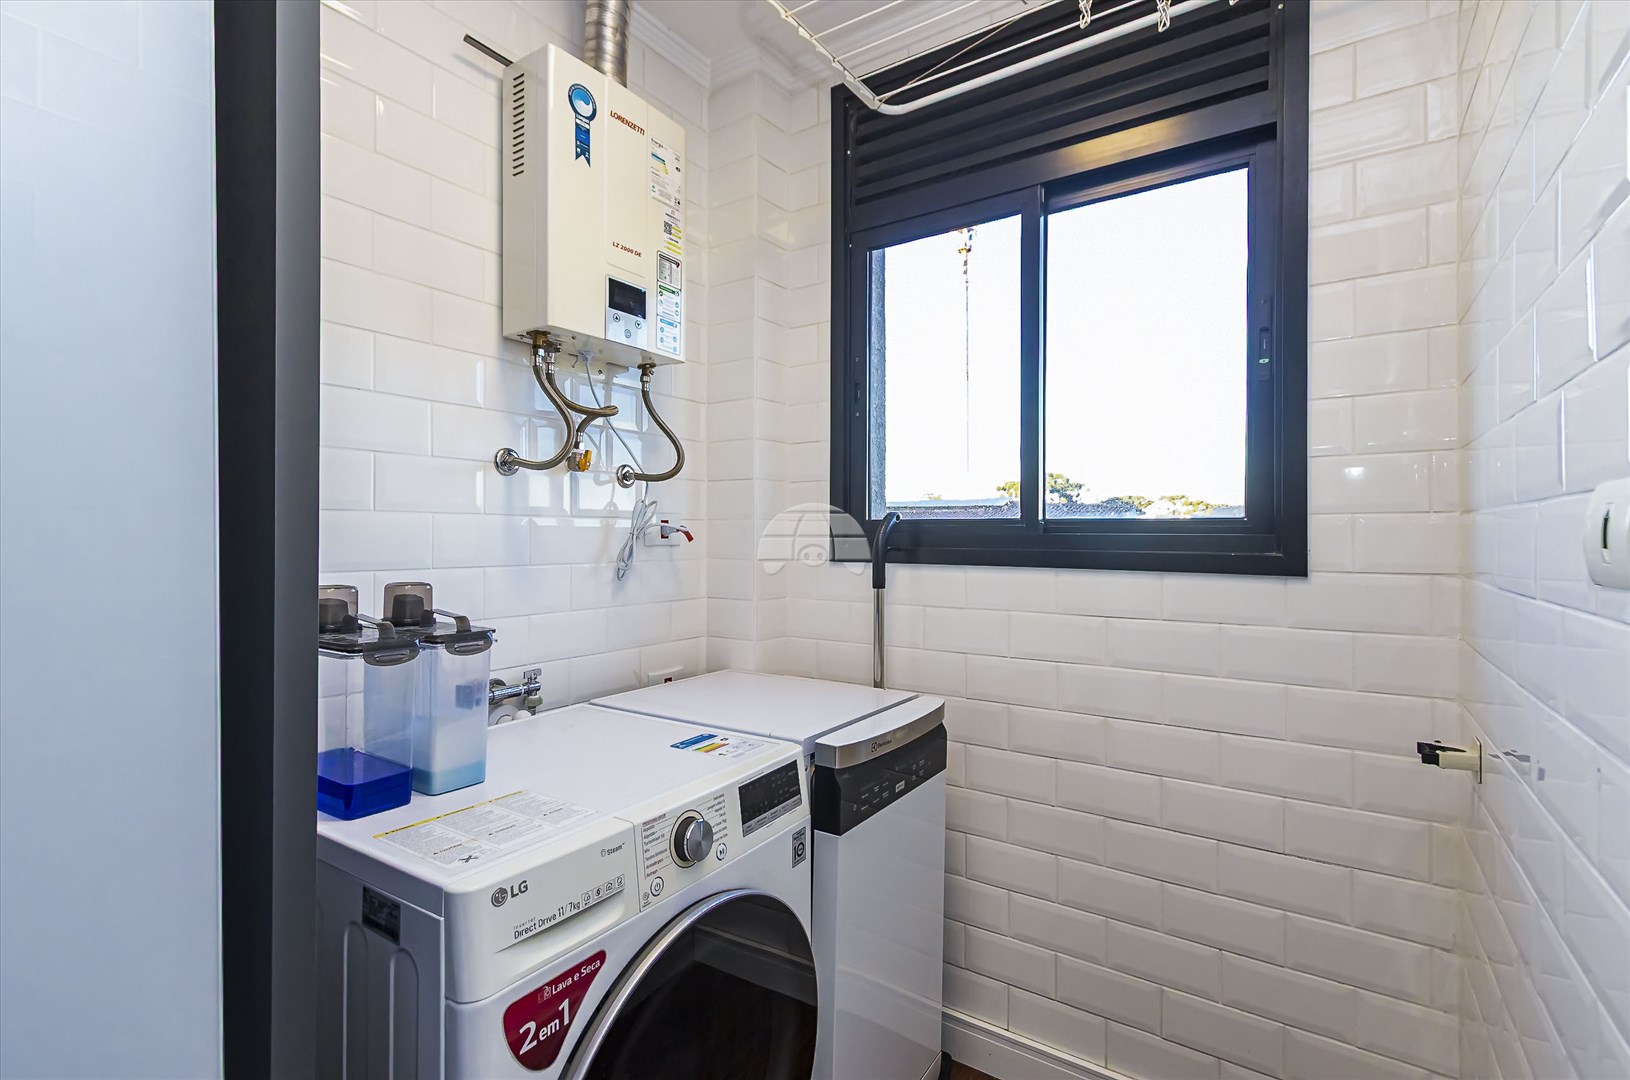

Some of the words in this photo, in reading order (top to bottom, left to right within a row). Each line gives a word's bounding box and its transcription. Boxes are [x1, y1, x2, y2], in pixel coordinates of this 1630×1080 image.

[610, 110, 645, 136] LORENZETTI
[612, 241, 620, 249] LZ
[620, 245, 634, 254] 2000
[634, 250, 642, 258] DE
[510, 880, 529, 898] LG
[514, 923, 537, 939] Direct
[538, 914, 557, 928] Drive
[552, 977, 572, 995] Lava
[573, 972, 580, 981] e
[580, 959, 601, 977] Seca
[519, 1020, 538, 1056] 2
[539, 1018, 560, 1041] em
[558, 998, 570, 1026] 1
